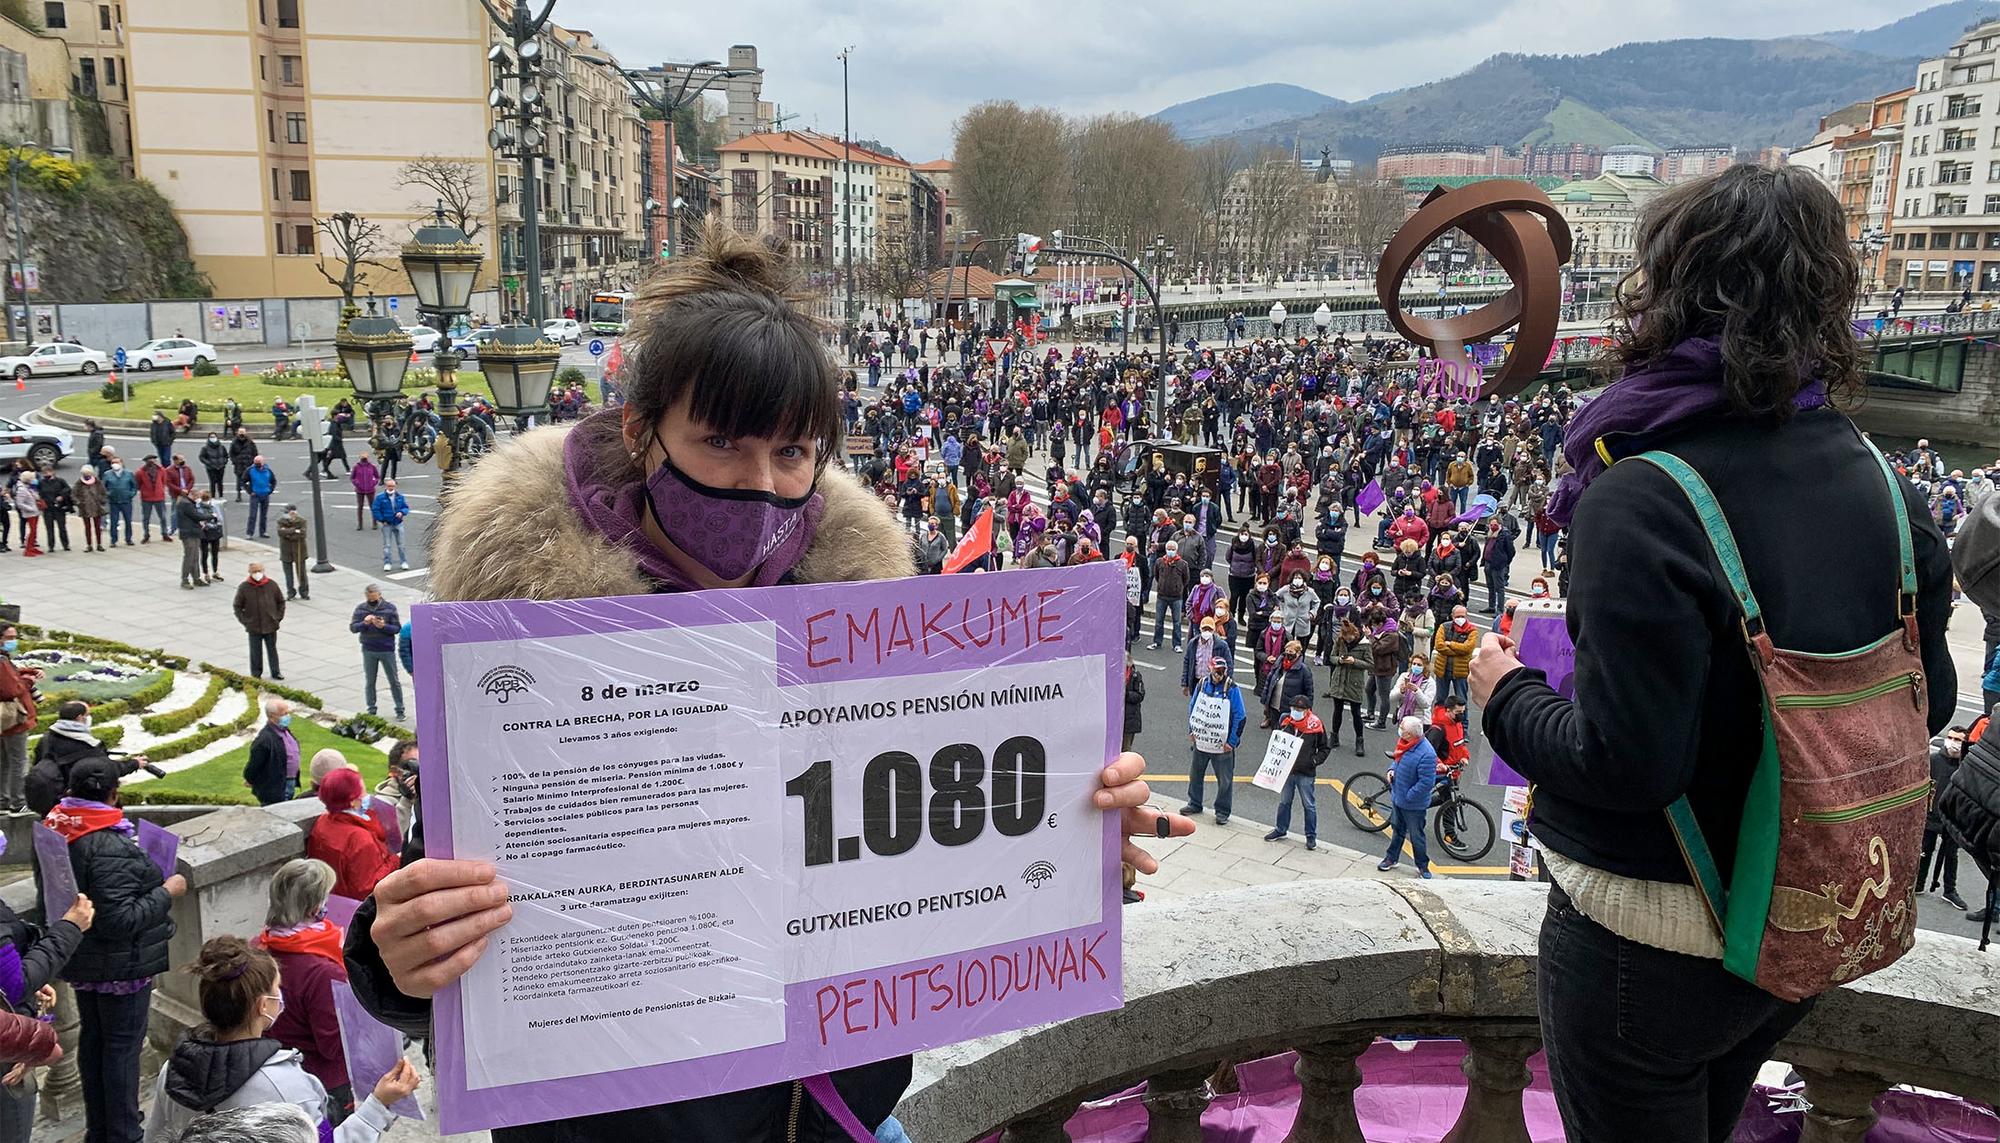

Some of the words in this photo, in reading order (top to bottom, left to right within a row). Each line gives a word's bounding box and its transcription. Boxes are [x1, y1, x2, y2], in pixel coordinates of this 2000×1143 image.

[763, 512, 796, 556] HASTA
[806, 588, 1064, 668] EMAKUME
[495, 680, 520, 689] MPB
[581, 686, 594, 701] 8
[601, 685, 627, 699] de
[635, 680, 700, 696] marzo
[503, 720, 552, 733] CONTRA
[556, 718, 570, 728] LA
[574, 713, 624, 726] BRECHA,
[628, 710, 650, 721] POR
[655, 708, 668, 718] LA
[672, 702, 728, 716] IGUALDAD
[780, 700, 897, 729] APOYAMOS
[903, 690, 985, 716] PENSIÓN
[991, 683, 1064, 706] MÍNIMA
[559, 734, 600, 744] Llevamos
[603, 731, 608, 740] 3
[611, 730, 631, 739] años
[634, 725, 678, 737] exigiendo:
[502, 770, 526, 780] 100%
[529, 770, 540, 778] de
[542, 769, 550, 777] la
[553, 765, 587, 778] pensión
[590, 764, 600, 772] de
[603, 763, 615, 771] los
[618, 760, 658, 770] cónyuges
[661, 757, 679, 767] para
[682, 754, 694, 763] las
[697, 751, 725, 761] viudas.
[502, 783, 538, 793] Ninguna
[542, 778, 575, 791] pensión
[578, 776, 588, 785] de
[592, 772, 625, 783] miseria.
[628, 768, 662, 779] Pensión
[697, 763, 706, 772] de
[710, 759, 736, 770] 1.080€
[738, 761, 743, 769] y
[503, 793, 534, 803] Salario
[571, 781, 639, 797] Interprofesional
[642, 780, 652, 789] de
[655, 776, 685, 788] 1.200€.
[504, 804, 542, 815] Trabajos
[545, 802, 555, 811] de
[558, 798, 597, 810] cuidados
[600, 796, 618, 805] bien
[621, 790, 676, 803] remunerados
[678, 789, 696, 799] para
[699, 786, 711, 794] las
[714, 783, 748, 793] mujeres.
[504, 815, 545, 826] Servicios
[548, 811, 583, 822] sociales
[586, 808, 622, 820] públicos
[625, 806, 643, 816] para
[646, 803, 658, 812] las
[661, 800, 699, 812] personas
[505, 826, 567, 839] dependientes.
[506, 838, 544, 849] Atención
[612, 826, 655, 839] específica
[657, 825, 676, 835] para
[678, 820, 711, 831] mujeres
[714, 816, 750, 827] mayores.
[506, 852, 518, 860] No
[521, 850, 529, 859] al
[531, 849, 564, 859] copago
[566, 840, 625, 855] farmacéutico.
[506, 888, 574, 902] RRAKALAREN
[578, 884, 616, 896] AURKA,
[619, 869, 716, 892] BERDINTASUNAREN
[720, 864, 744, 877] ALDE
[560, 903, 566, 911] 3
[569, 902, 587, 910] urte
[786, 901, 912, 936] GUTXIENEKO
[917, 884, 1007, 914] PENTSIOA
[510, 931, 558, 944] Ezkontideek
[618, 923, 639, 932] duten
[511, 942, 552, 954] Miseriazko
[555, 936, 594, 951] pentsiorik
[722, 918, 734, 926] eta
[512, 952, 542, 963] Lanbide
[545, 949, 570, 960] arteko
[652, 934, 680, 946] 1.200€.
[512, 963, 532, 973] Ondo
[536, 957, 587, 970] ordaindutako
[512, 971, 548, 982] Mendeko
[551, 964, 610, 980] pertsonentzako
[513, 981, 544, 992] Adineko
[547, 972, 616, 988] emakumeentzako
[619, 970, 642, 979] arreta
[513, 989, 565, 1001] Koordainketa
[568, 979, 629, 995] farmazeutikoari
[816, 931, 1108, 1046] PENTSIODUNAK
[528, 1018, 563, 1029] Mujeres
[566, 1014, 578, 1024] del
[580, 1009, 630, 1022] Movimiento
[633, 1006, 642, 1015] de
[645, 1000, 694, 1013] Pensionistas
[697, 996, 706, 1005] de
[708, 991, 736, 1003] Bizkaia
